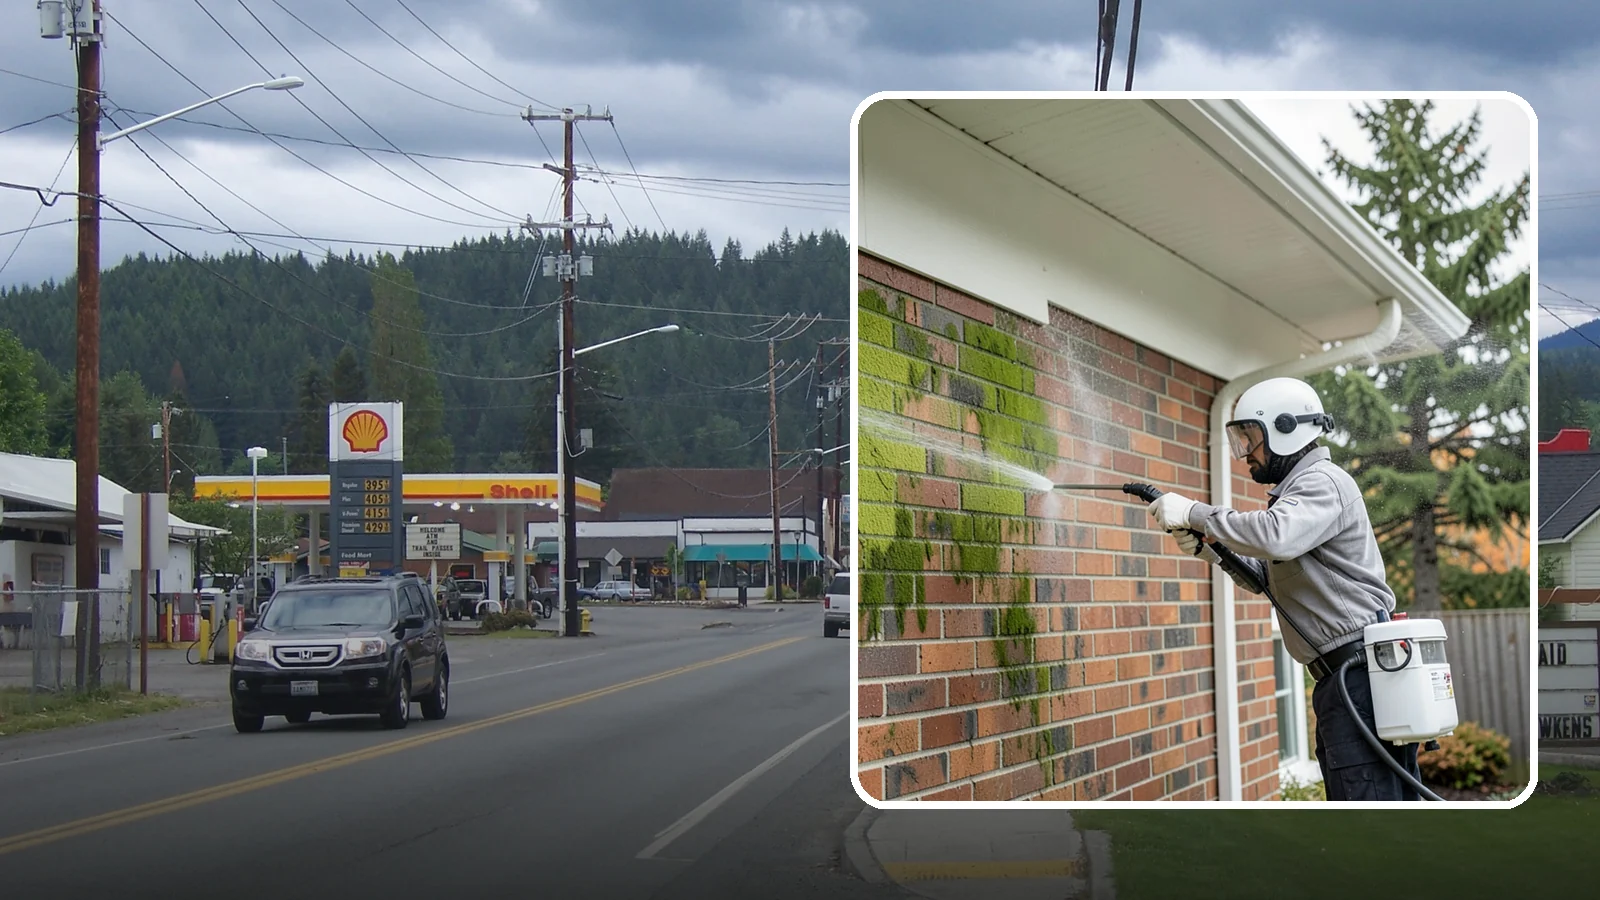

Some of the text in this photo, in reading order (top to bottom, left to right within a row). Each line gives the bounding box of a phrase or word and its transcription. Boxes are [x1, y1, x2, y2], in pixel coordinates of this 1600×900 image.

[365, 480, 384, 490] 395
[490, 484, 547, 499] Shell
[365, 494, 384, 504] 405
[365, 508, 384, 518] 415
[365, 522, 384, 532] 429
